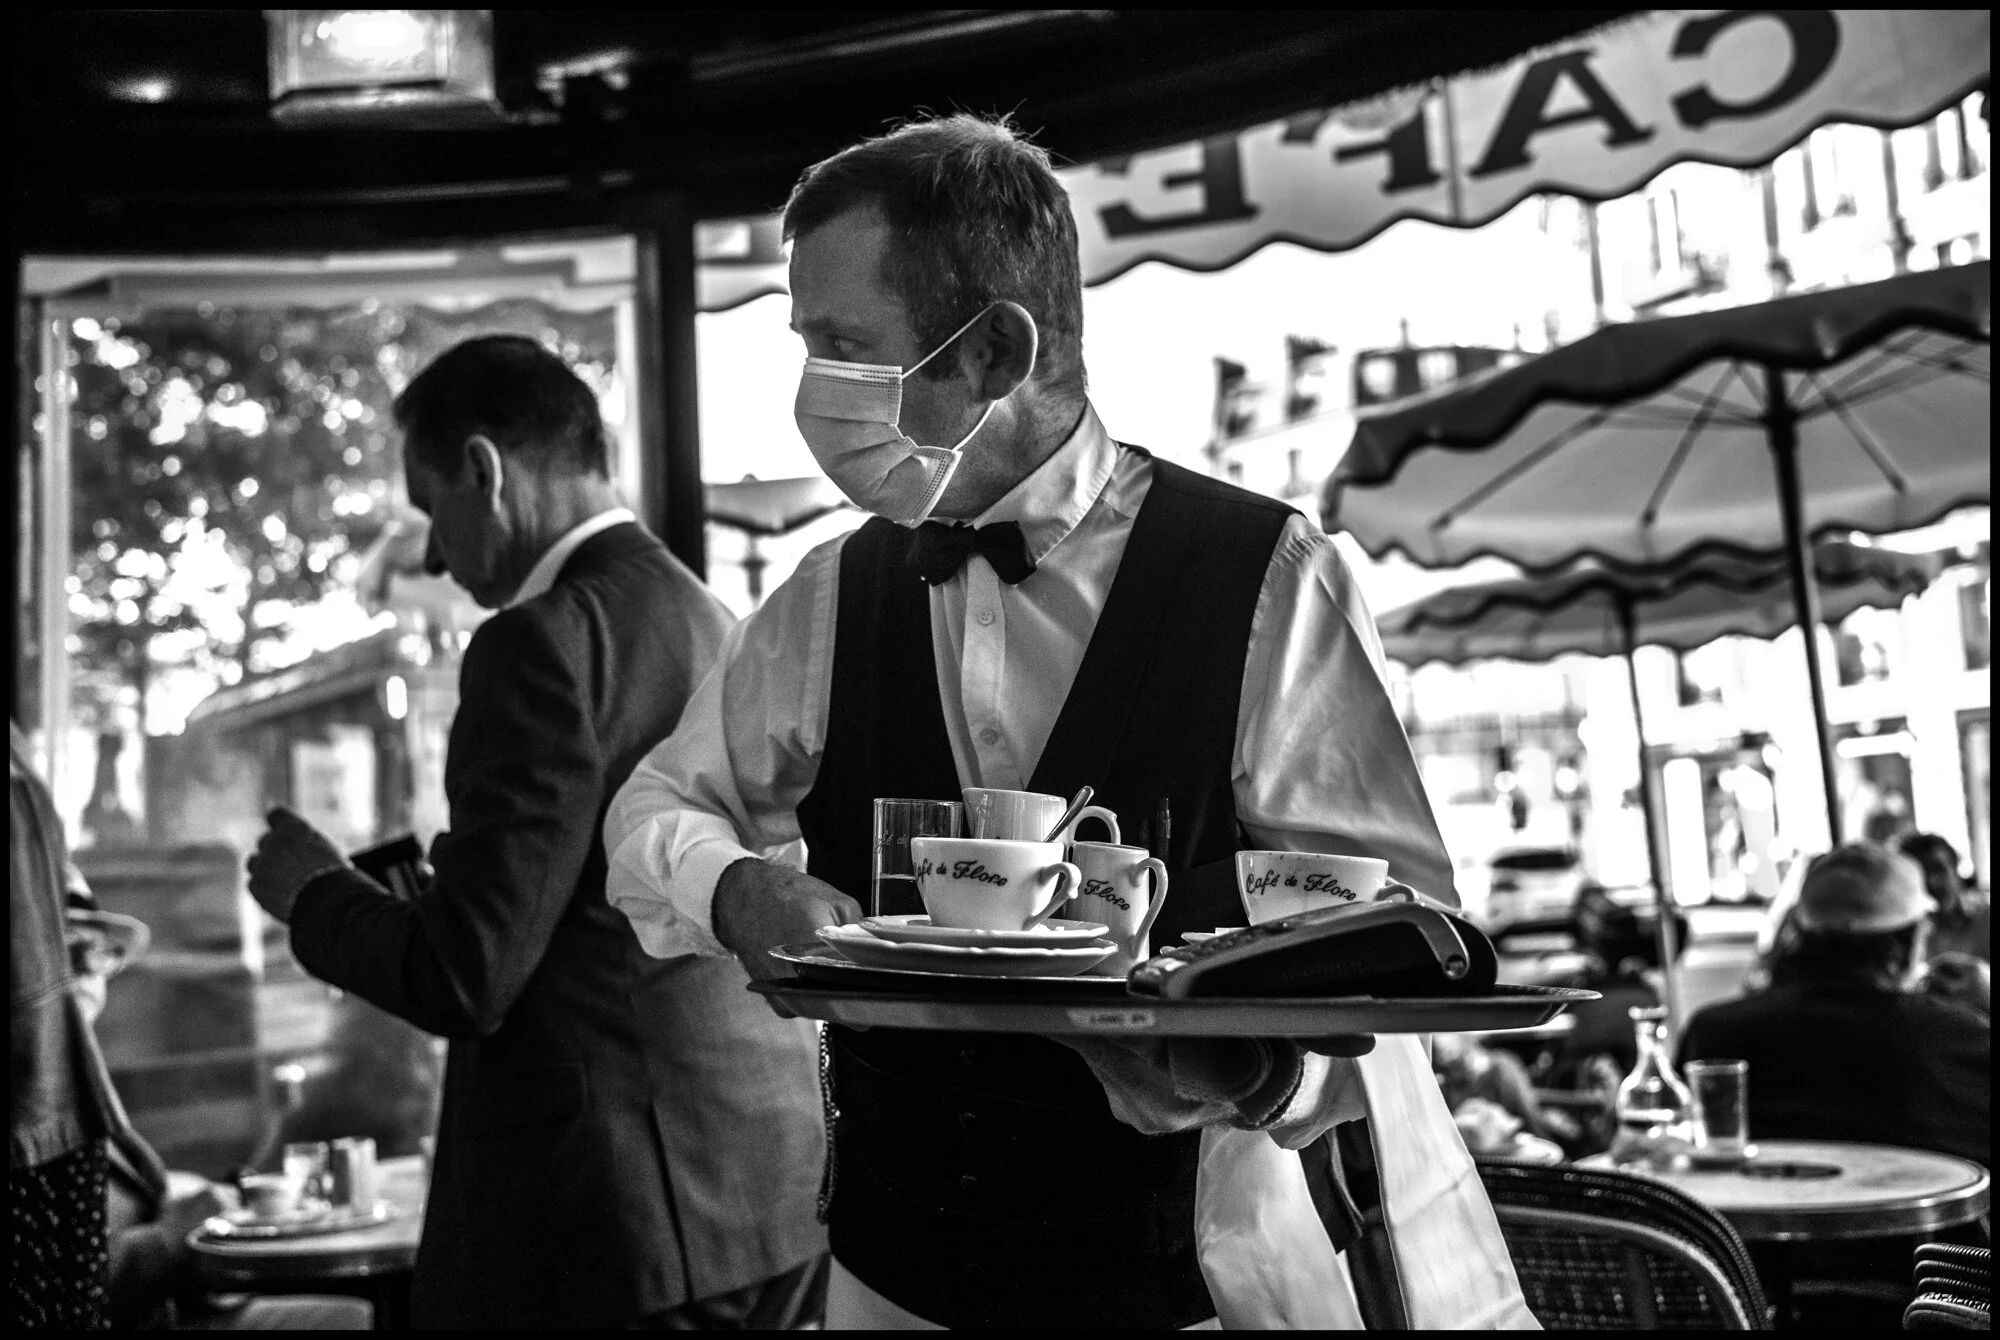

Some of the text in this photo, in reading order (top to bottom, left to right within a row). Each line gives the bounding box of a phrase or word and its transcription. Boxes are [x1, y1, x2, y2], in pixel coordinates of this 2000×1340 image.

[936, 862, 947, 875] de
[952, 860, 1008, 886] Flore
[1246, 869, 1356, 901] Café de Flore
[1083, 879, 1131, 911] Flore
